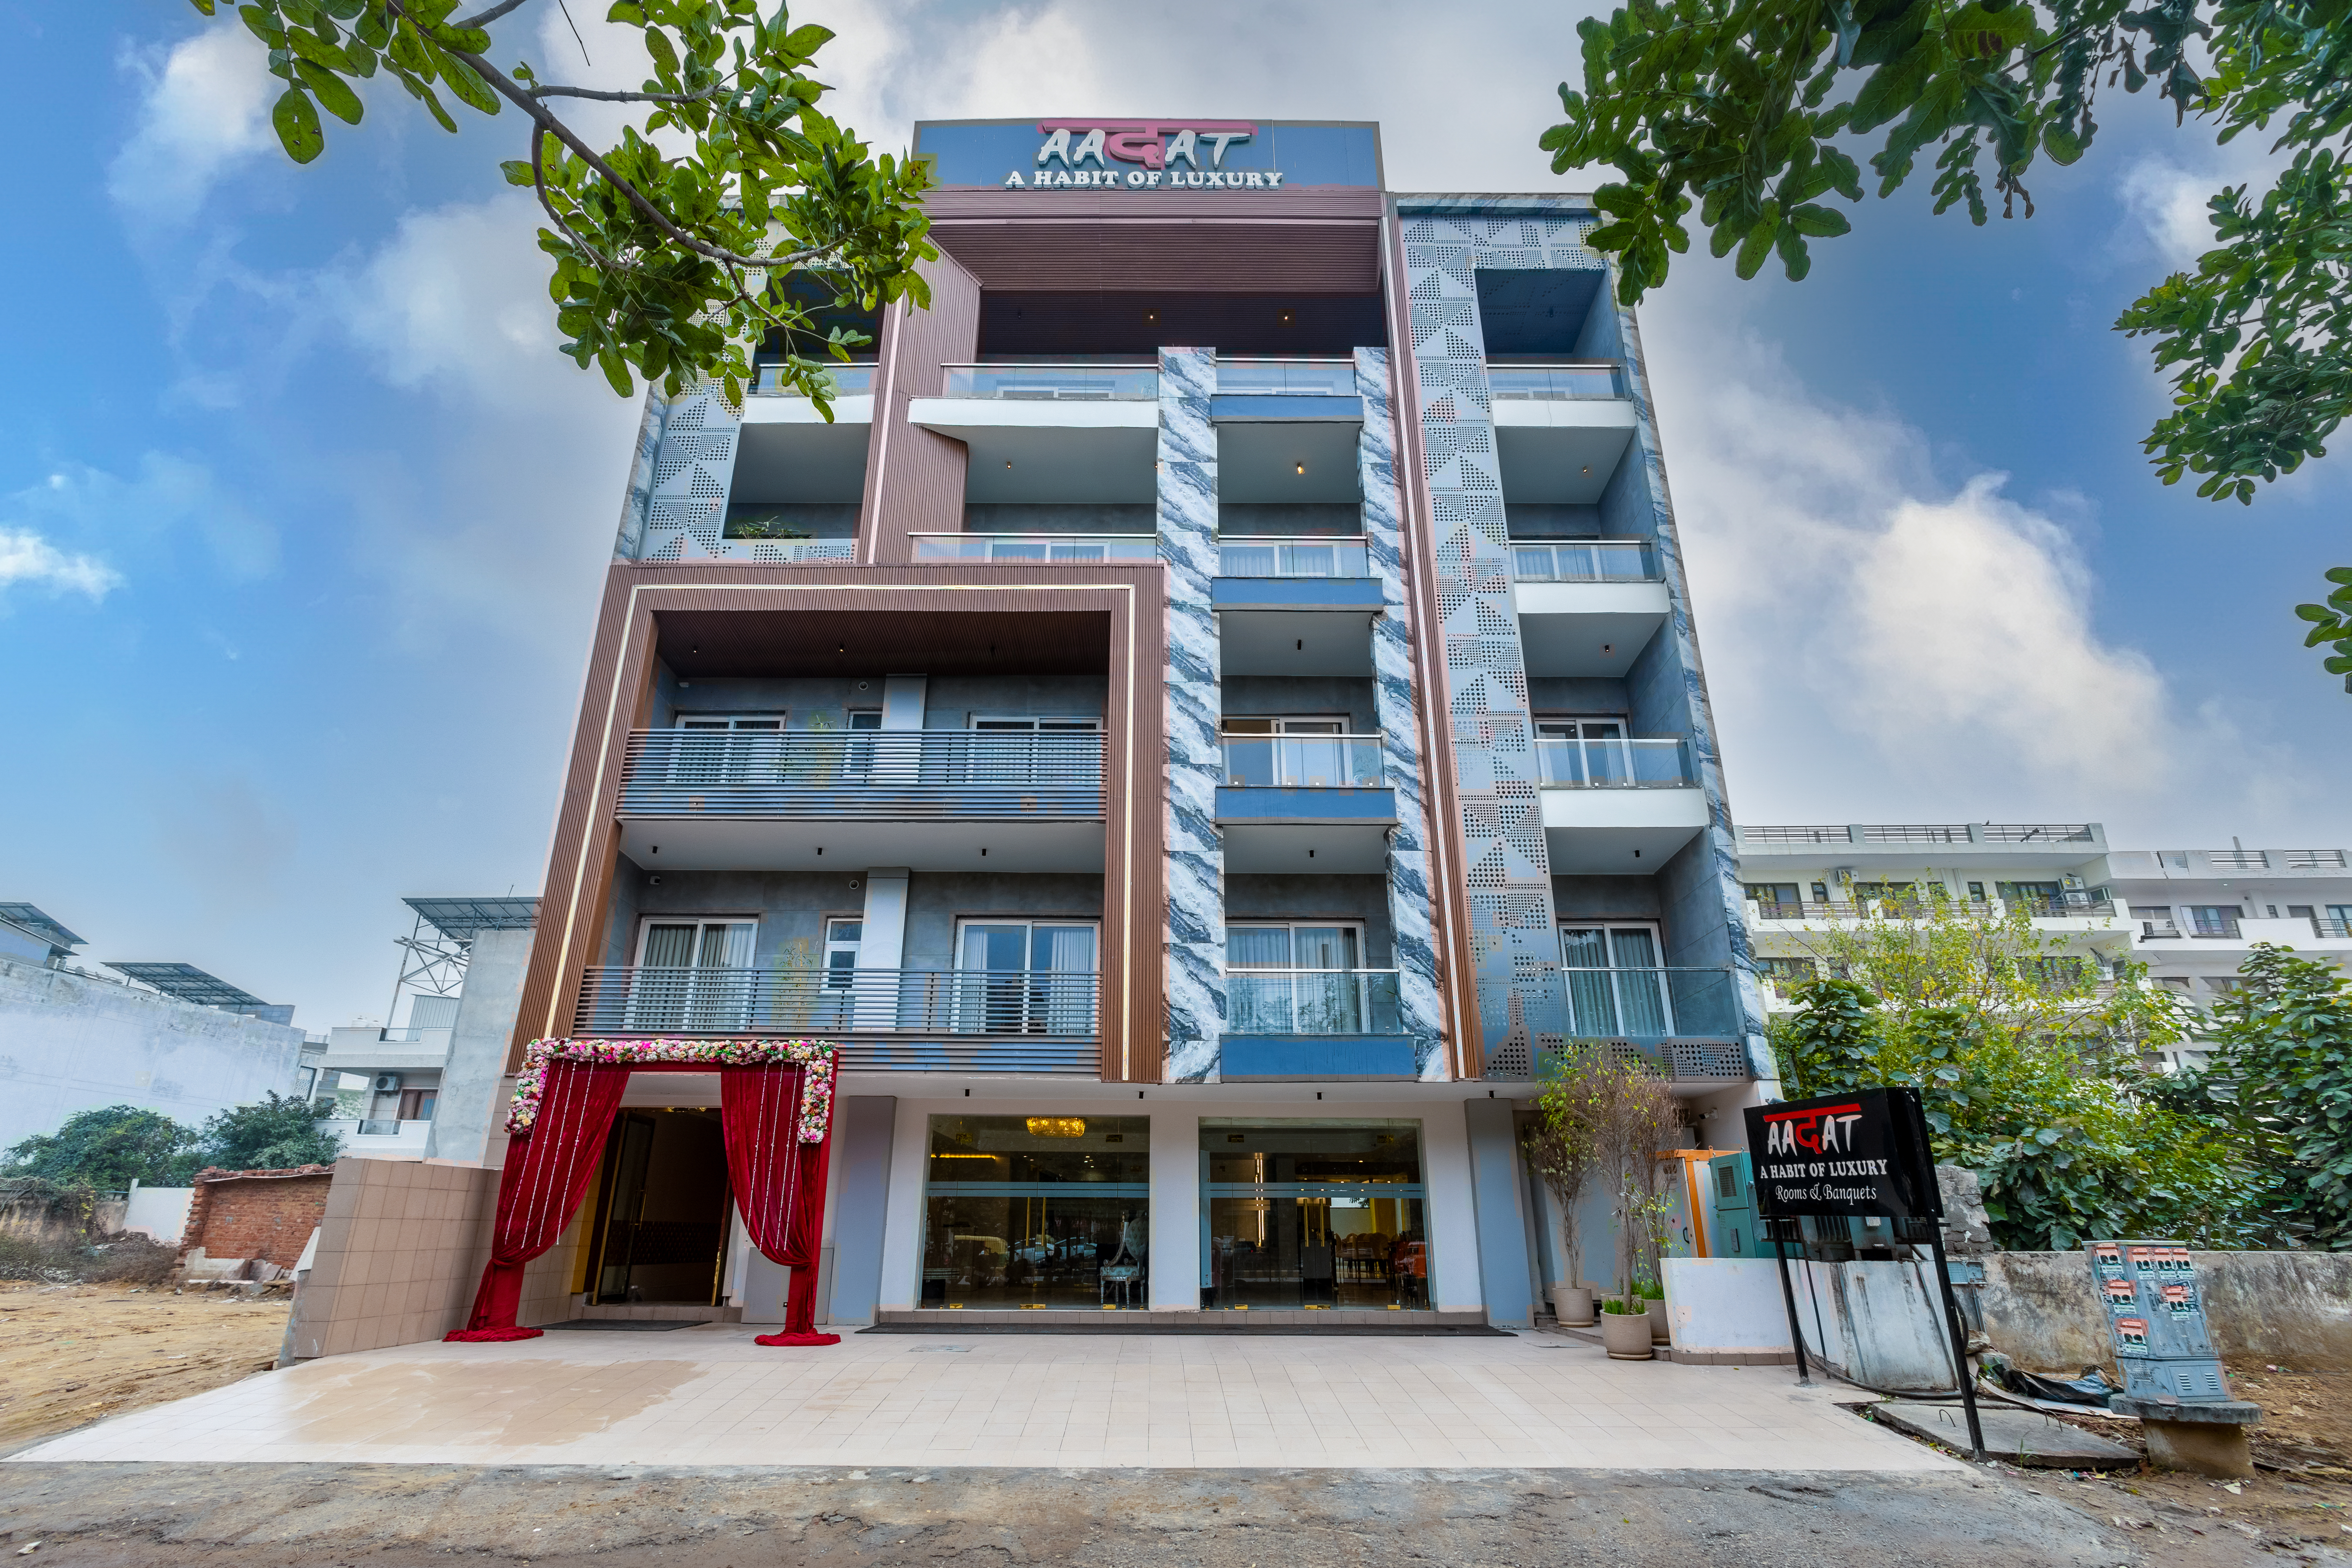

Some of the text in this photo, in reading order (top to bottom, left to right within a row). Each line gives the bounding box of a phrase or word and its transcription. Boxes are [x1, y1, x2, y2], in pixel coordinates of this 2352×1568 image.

[1005, 171, 1283, 189] A HABIT OF LUXURY
[1760, 1159, 1887, 1178] A HABIT OF LUXURY
[1776, 1185, 1807, 1202] Rooms
[1823, 1184, 1876, 1205] Banquets
